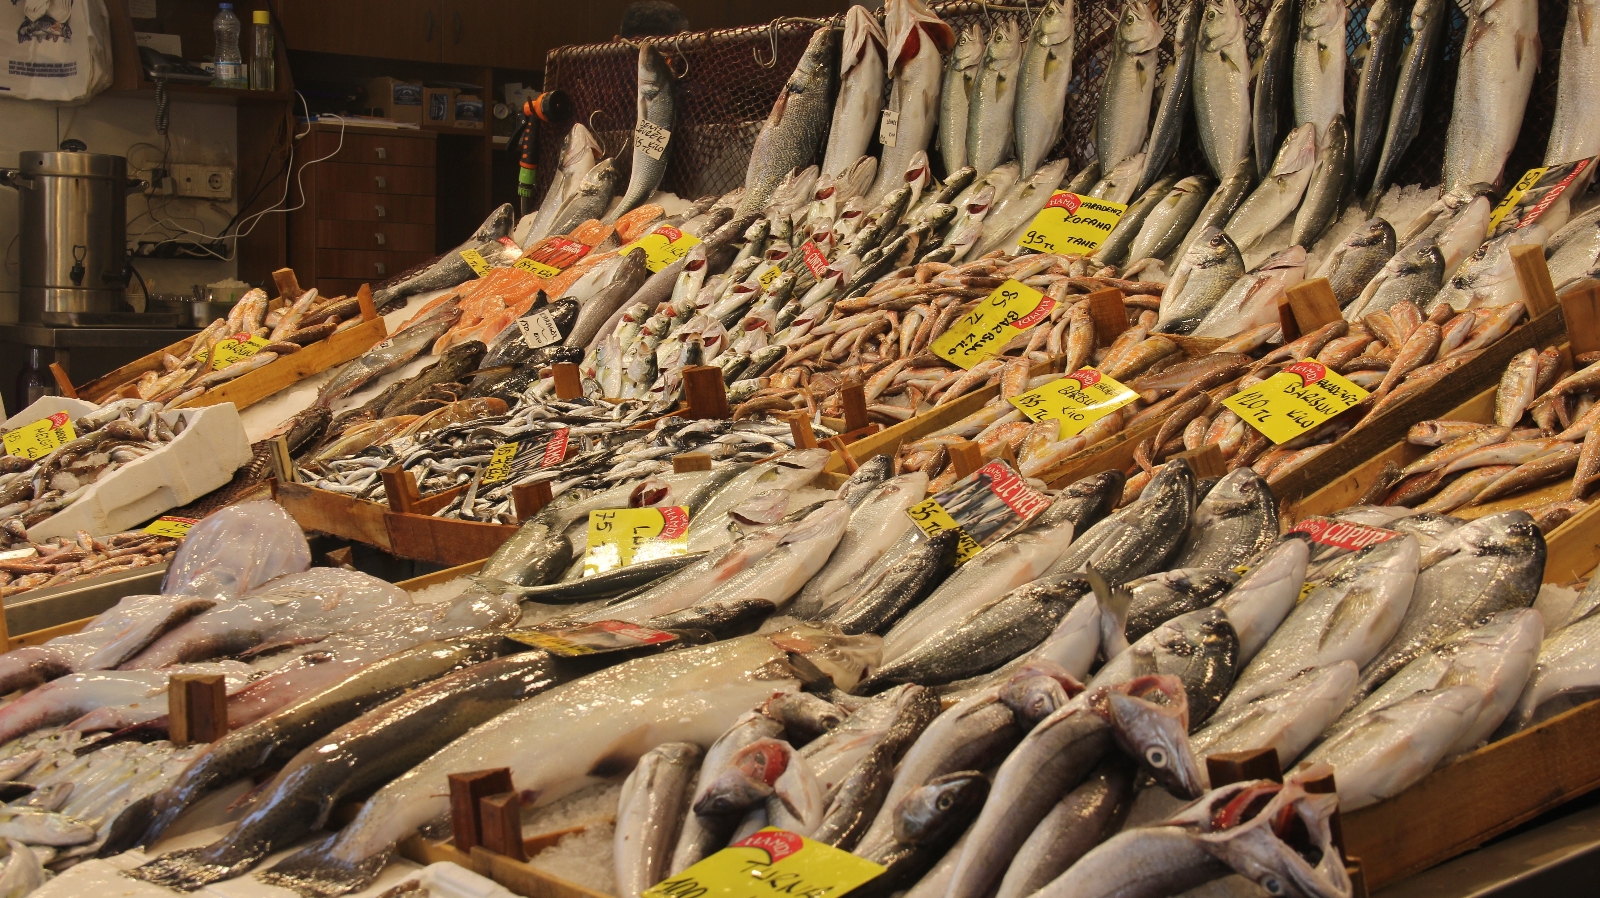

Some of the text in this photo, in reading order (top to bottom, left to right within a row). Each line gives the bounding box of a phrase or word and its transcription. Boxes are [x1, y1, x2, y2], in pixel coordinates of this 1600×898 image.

[1516, 171, 1541, 191] 50
[1063, 214, 1112, 232] KOFANA
[1022, 230, 1055, 251] 95 TL
[1066, 236, 1098, 250] TANE
[964, 312, 984, 325] TL
[1235, 390, 1271, 410] 120
[1254, 409, 1272, 423] TL
[911, 502, 940, 521] 35
[596, 511, 613, 532] 75
